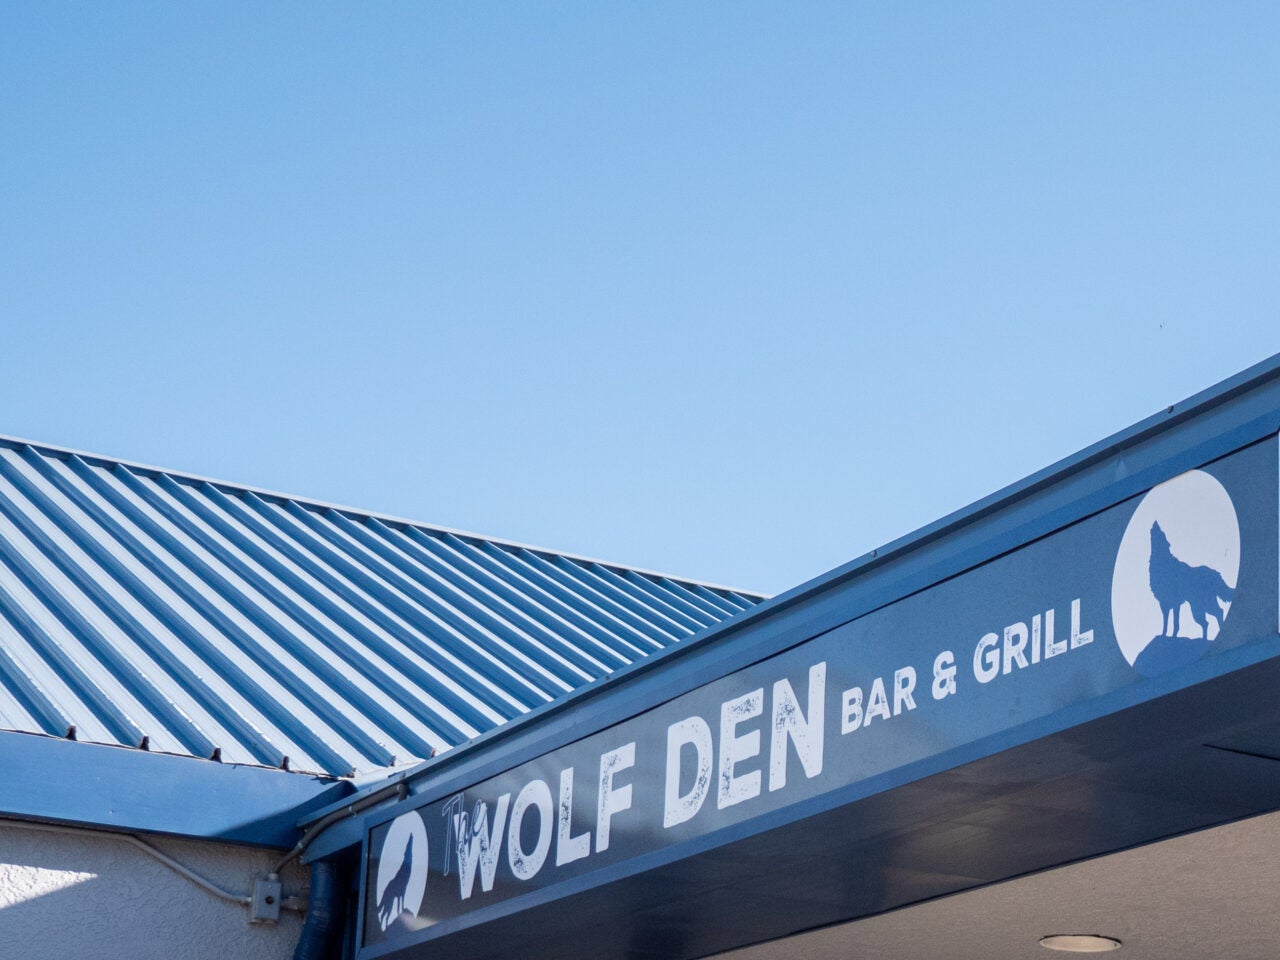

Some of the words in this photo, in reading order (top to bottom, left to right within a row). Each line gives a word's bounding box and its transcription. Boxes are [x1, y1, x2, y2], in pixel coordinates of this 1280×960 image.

[931, 650, 957, 700] &
[972, 598, 1094, 684] GRILL
[841, 665, 917, 736] BAR
[663, 661, 827, 829] DEN
[441, 792, 484, 876] The
[453, 741, 636, 900] WOLF
